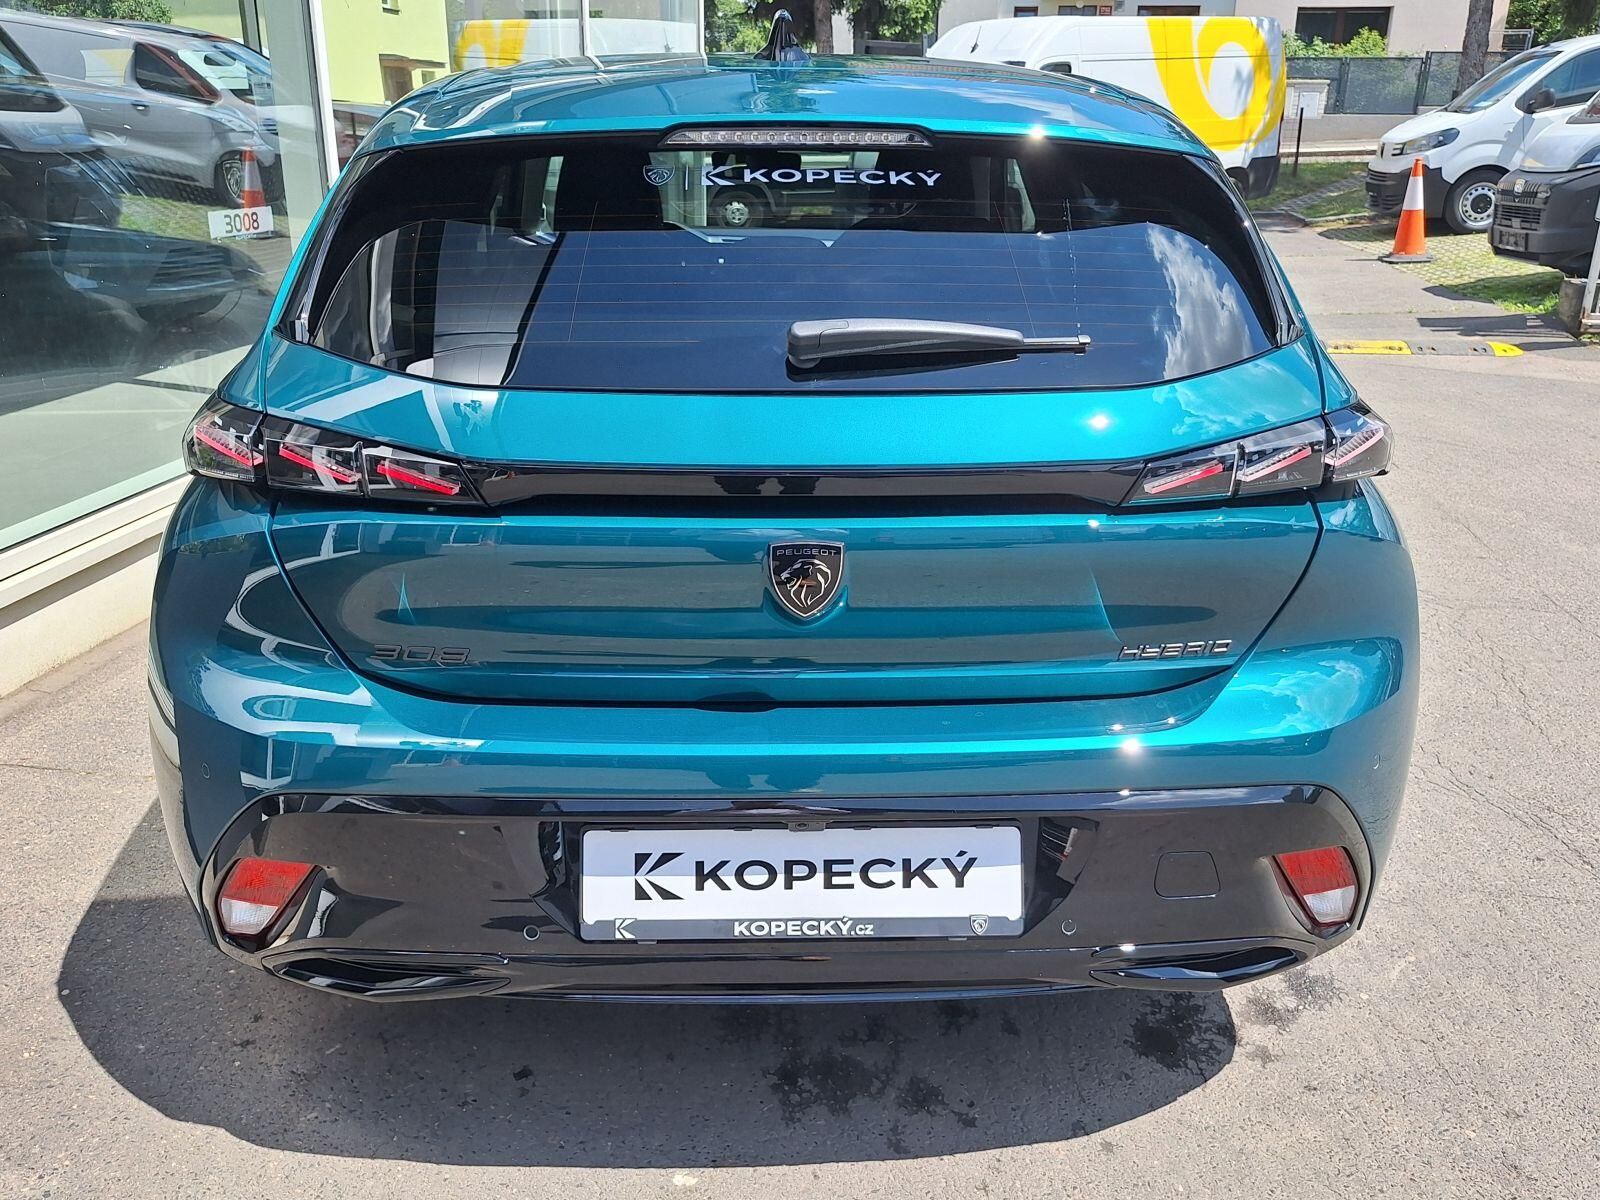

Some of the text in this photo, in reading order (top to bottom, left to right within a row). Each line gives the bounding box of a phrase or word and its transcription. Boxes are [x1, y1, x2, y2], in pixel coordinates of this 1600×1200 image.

[743, 168, 942, 187] KOPECKÝ
[223, 211, 260, 234] 3008
[776, 548, 838, 557] PEUGEOT
[370, 643, 471, 664] 308
[1117, 639, 1233, 660] HYBRID
[695, 850, 979, 892] KOPECKÝ
[733, 916, 875, 938] KOPECKÝ.cz
